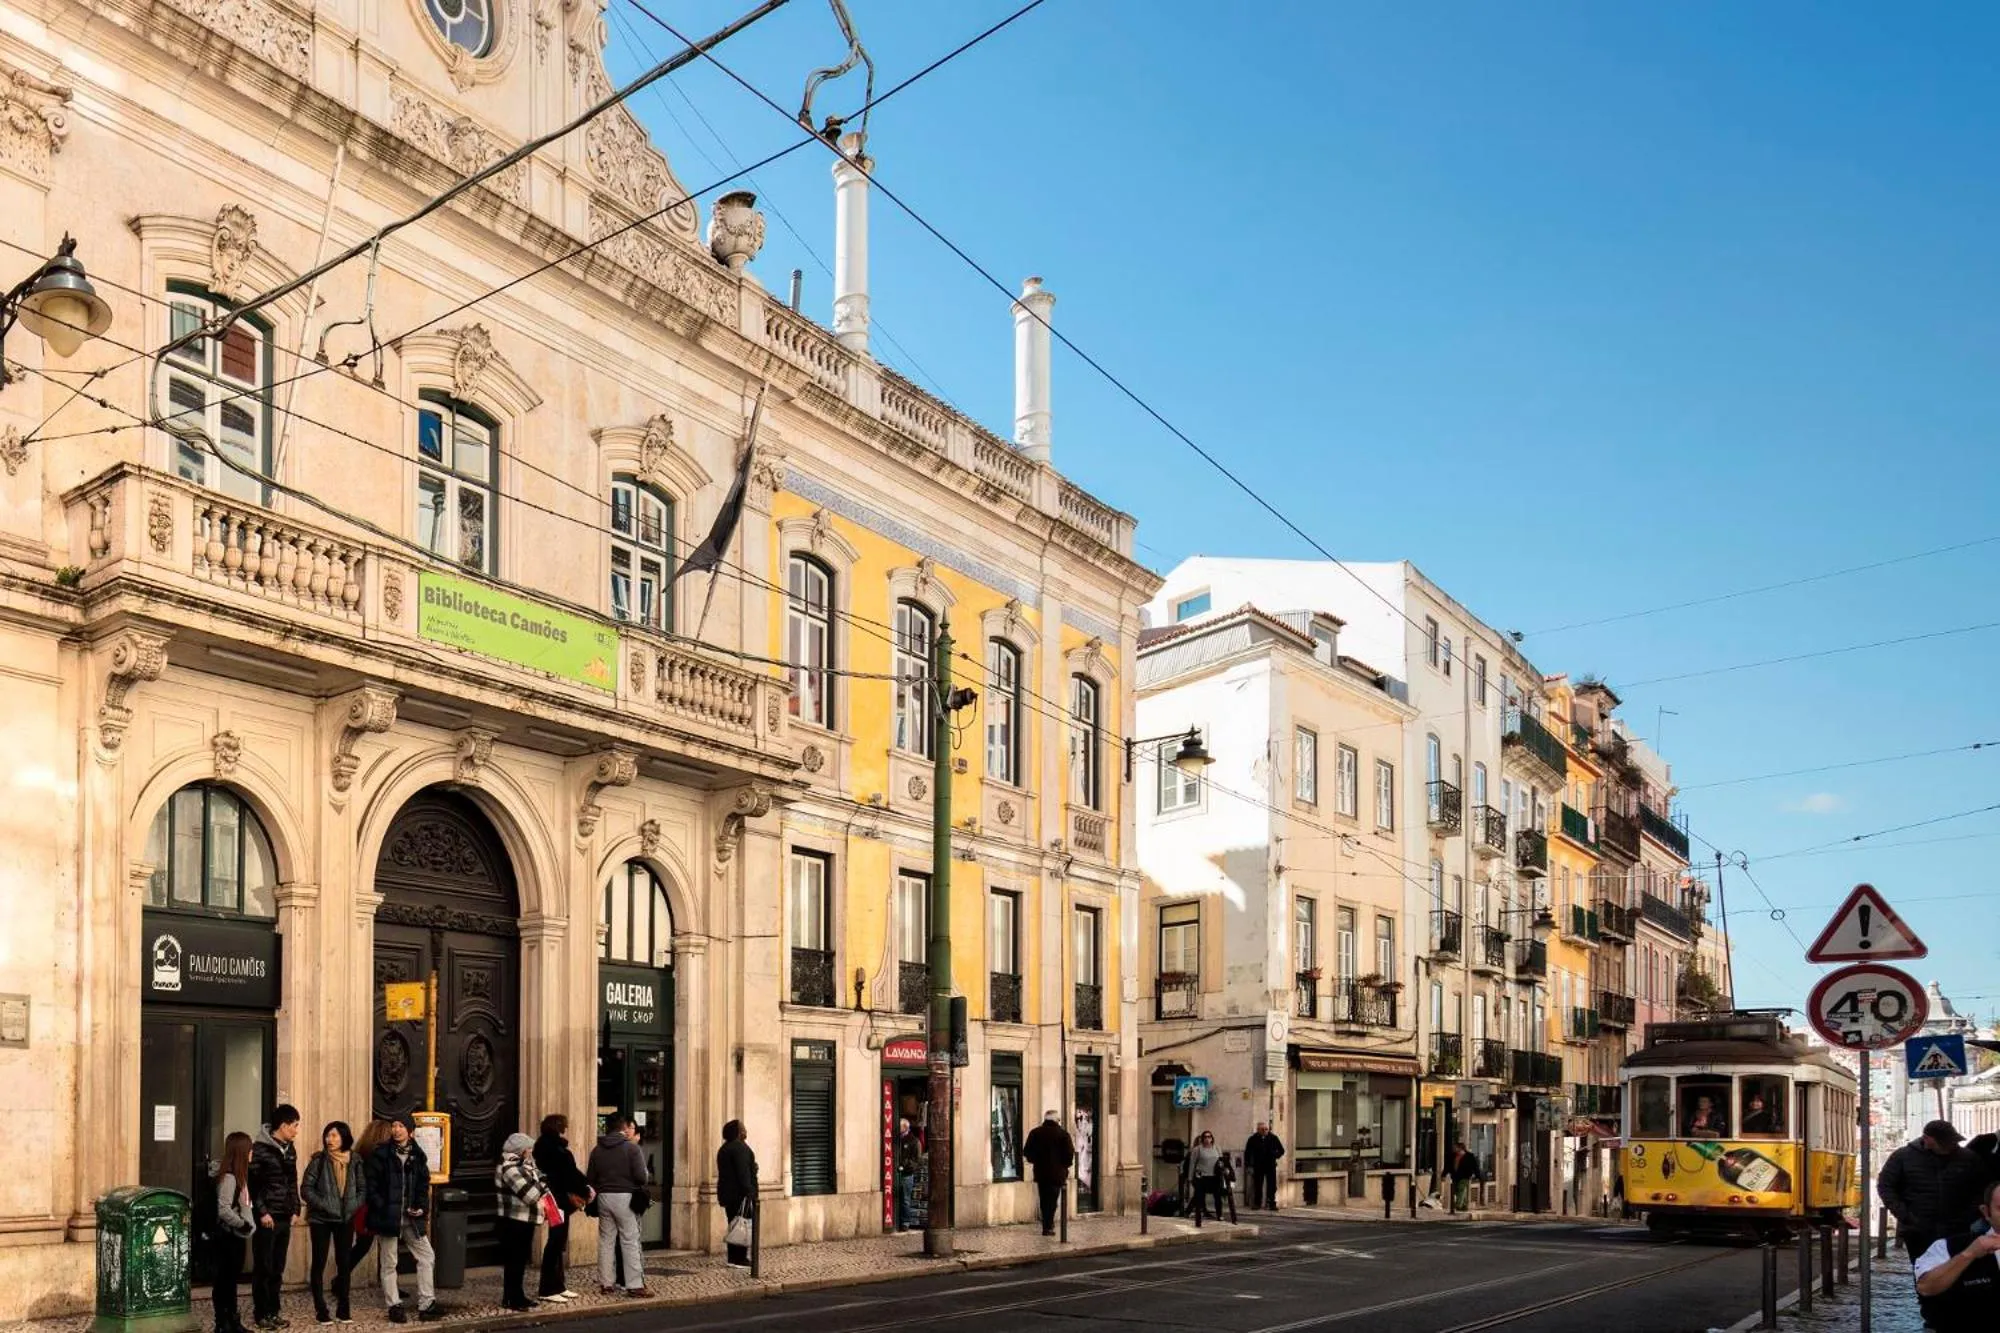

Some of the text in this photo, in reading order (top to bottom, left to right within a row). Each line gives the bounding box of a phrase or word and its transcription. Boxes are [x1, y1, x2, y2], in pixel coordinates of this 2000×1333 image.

[424, 586, 507, 626] Biblioteca
[510, 611, 568, 644] Camões
[189, 954, 266, 977] PALÁCIO CAMÕES
[606, 982, 653, 1007] GALERIA
[1826, 990, 1907, 1022] 40
[632, 1010, 654, 1023] SHOP
[883, 1085, 893, 1223] LAVANDARIA
